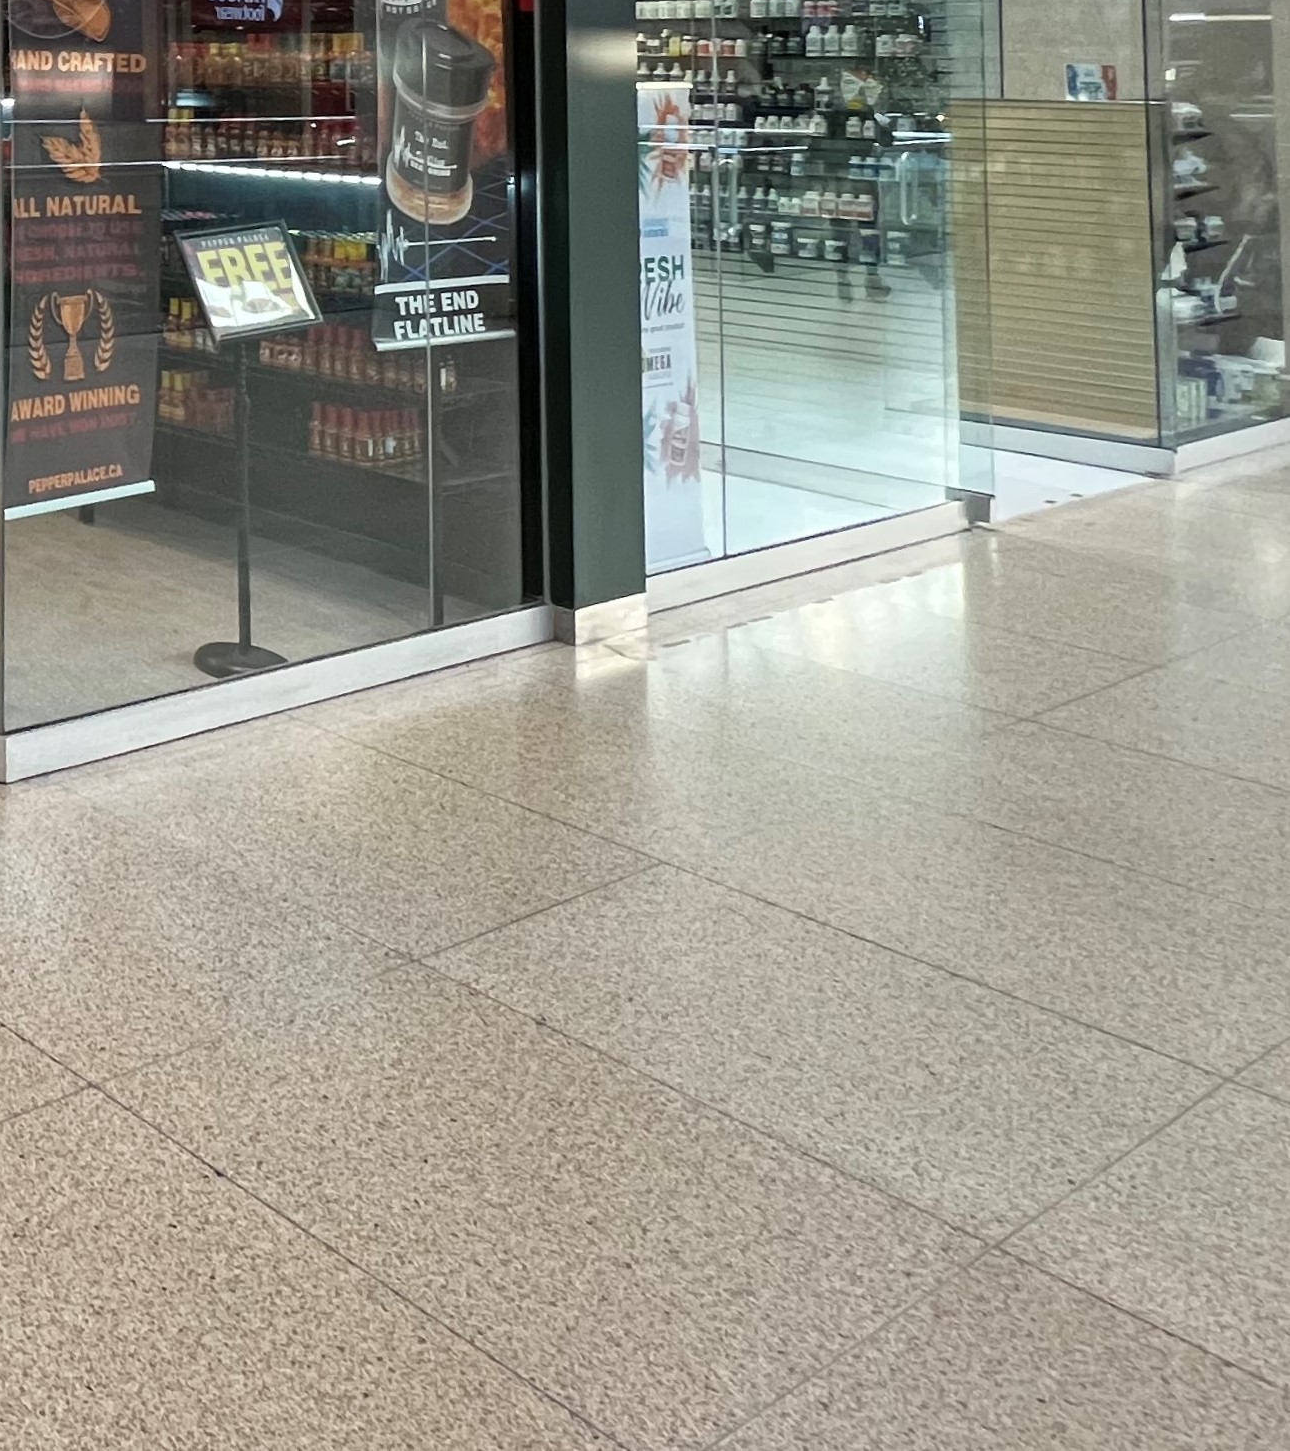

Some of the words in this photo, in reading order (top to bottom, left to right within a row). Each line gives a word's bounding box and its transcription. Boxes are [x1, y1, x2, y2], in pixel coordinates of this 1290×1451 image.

[57, 51, 147, 73] CRAFTED
[46, 194, 143, 217] NATURAL
[197, 241, 293, 291] FREE
[394, 294, 437, 316] THE
[440, 290, 480, 312] END
[642, 280, 686, 321] Vibe
[393, 313, 486, 341] FLATLINE
[10, 394, 65, 422] AWARD
[69, 384, 140, 413] WINNING
[28, 463, 124, 494] PEPPERPALACE.CA
